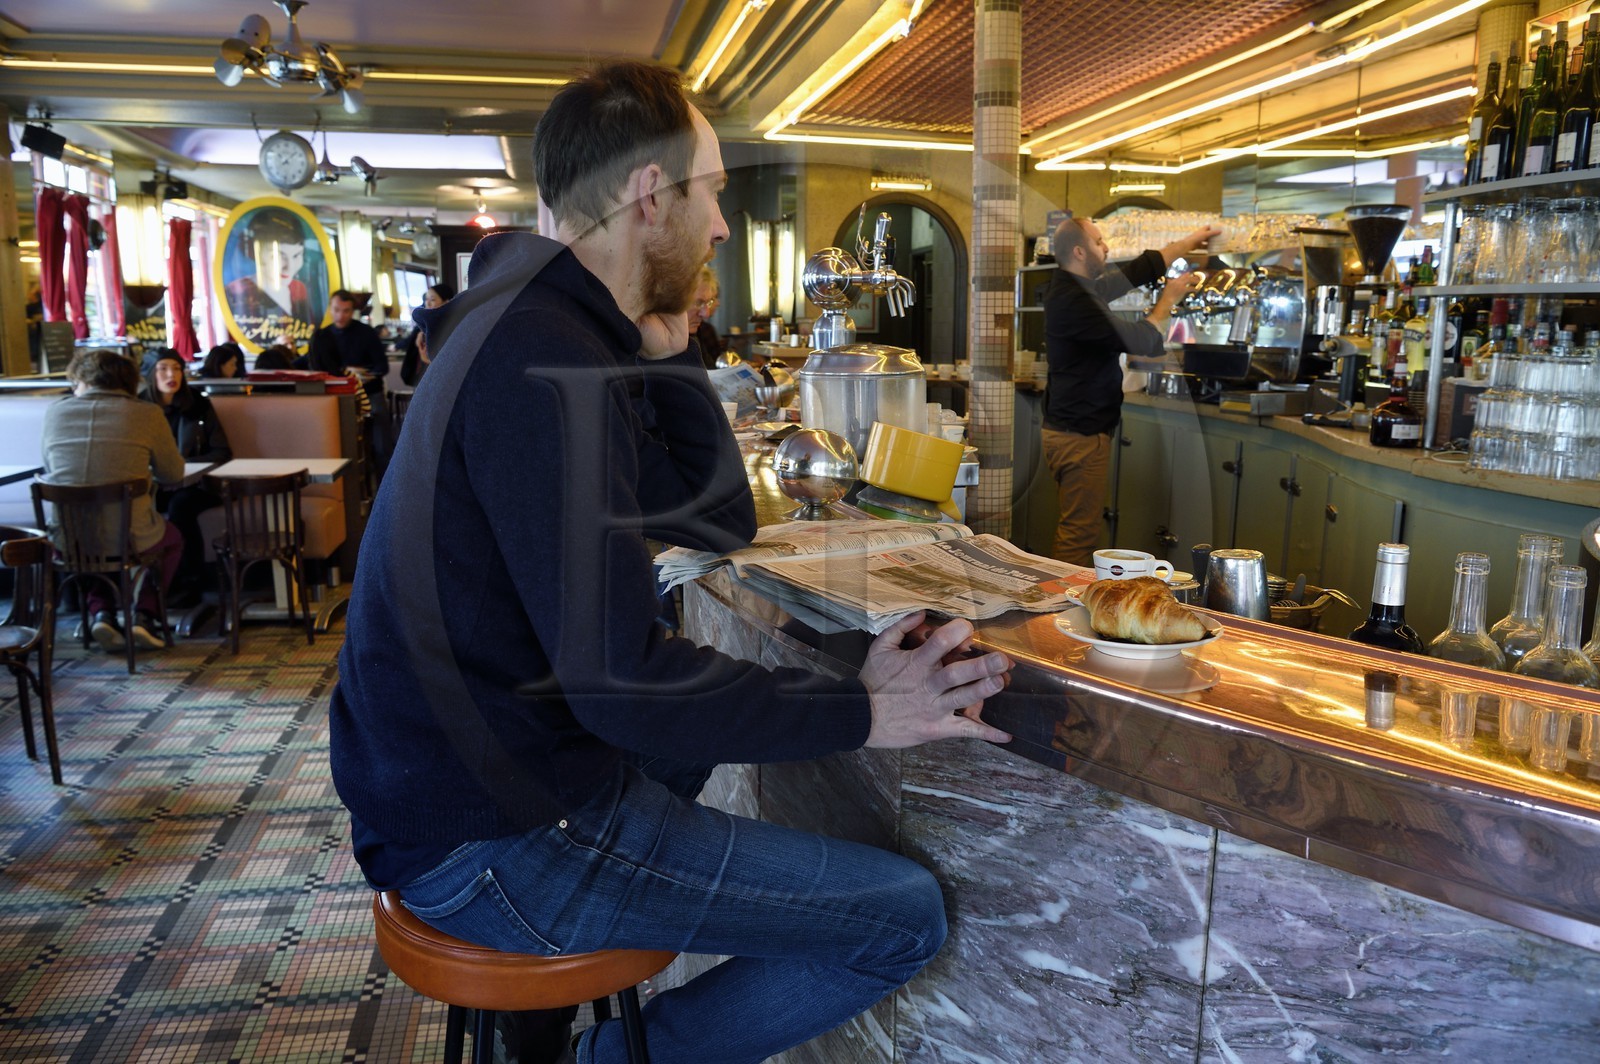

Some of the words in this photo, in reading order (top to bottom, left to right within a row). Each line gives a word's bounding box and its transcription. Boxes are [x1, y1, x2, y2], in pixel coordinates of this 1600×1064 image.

[950, 549, 995, 571] Journal
[991, 566, 1009, 574] de
[1007, 570, 1040, 581] Paris
